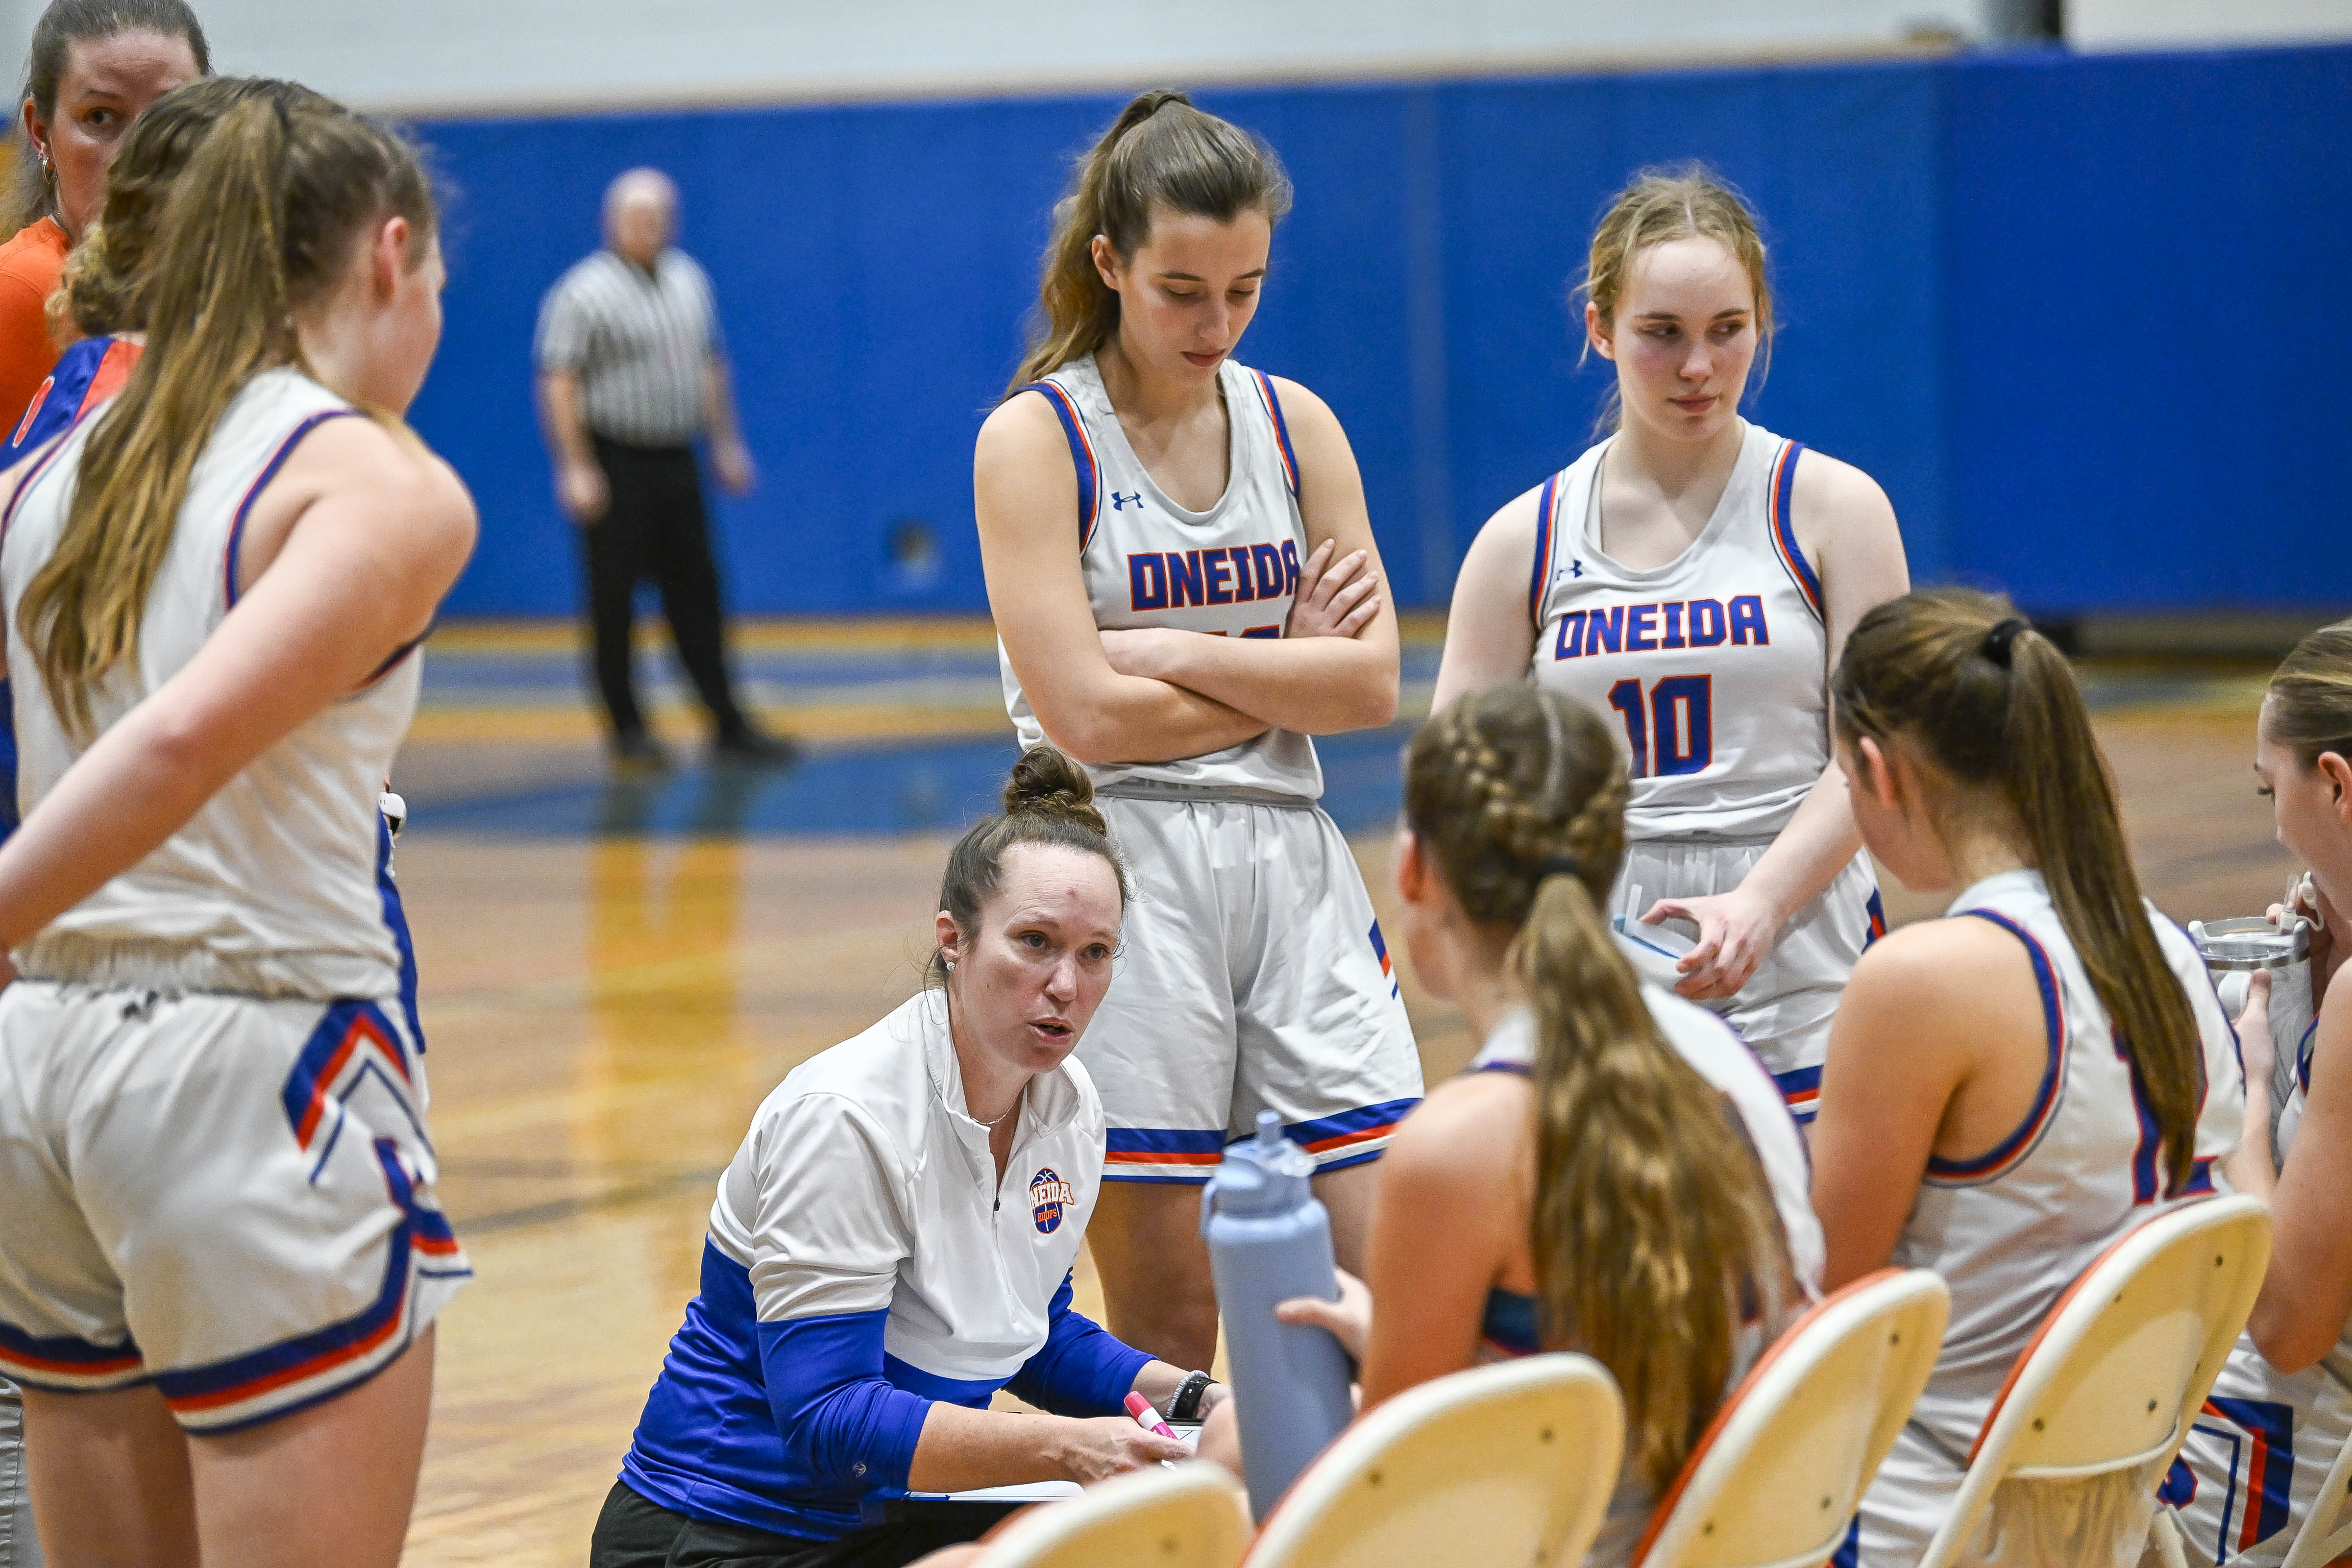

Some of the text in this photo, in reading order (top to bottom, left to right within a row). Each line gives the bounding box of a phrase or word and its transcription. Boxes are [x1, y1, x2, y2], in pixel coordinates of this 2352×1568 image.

[1127, 538, 1300, 612] ONEIDA
[1555, 594, 1770, 661] ONEIDA
[1608, 674, 1713, 777] 10
[1029, 1181, 1074, 1212] NEIDA
